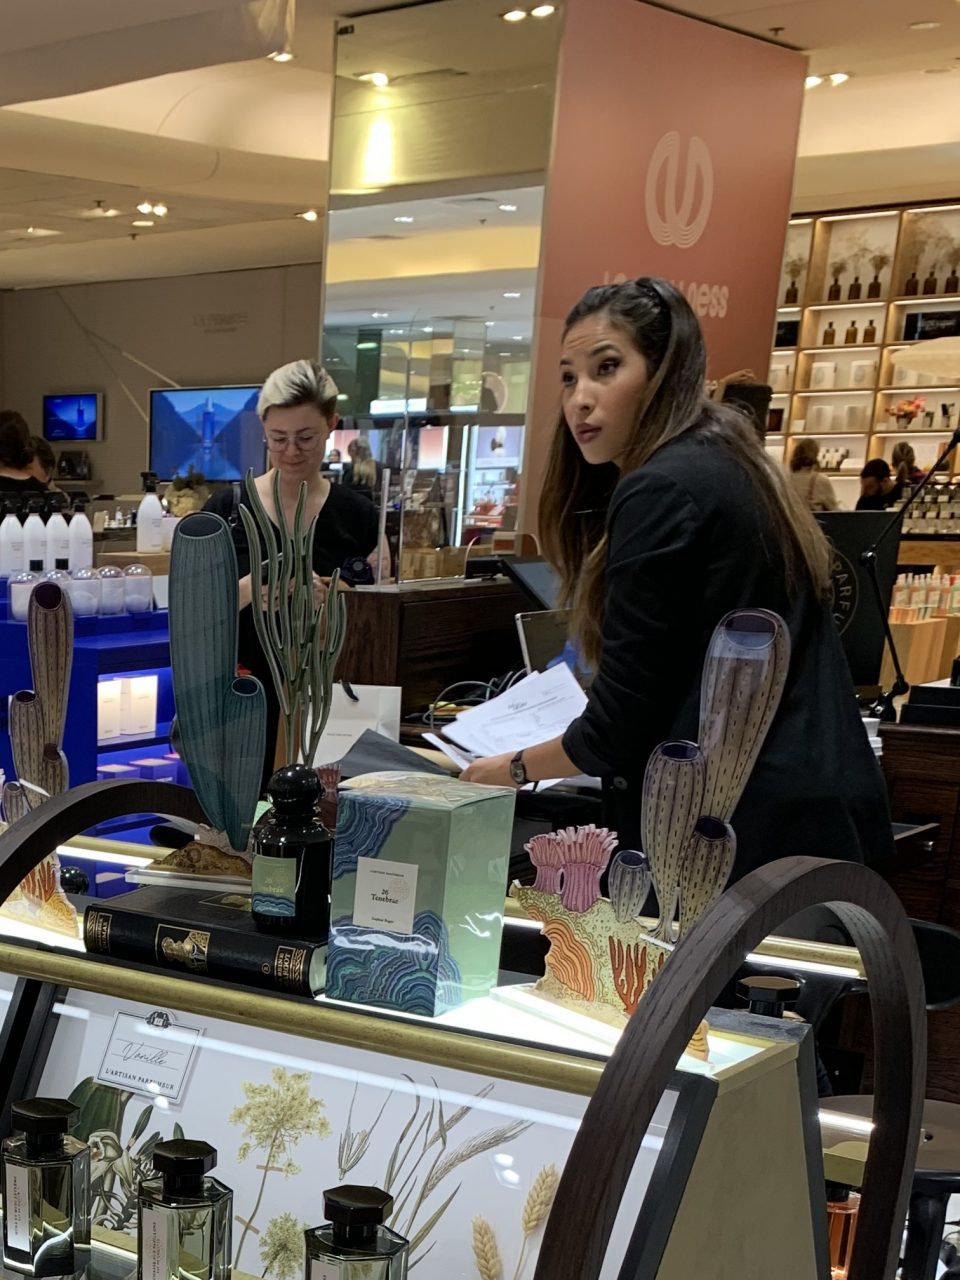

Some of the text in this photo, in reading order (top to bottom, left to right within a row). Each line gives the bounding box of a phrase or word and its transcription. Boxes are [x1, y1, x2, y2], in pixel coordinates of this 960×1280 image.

[122, 1042, 169, 1065] Vanille
[105, 1067, 175, 1091] L'ARTISAN PARFMEUR
